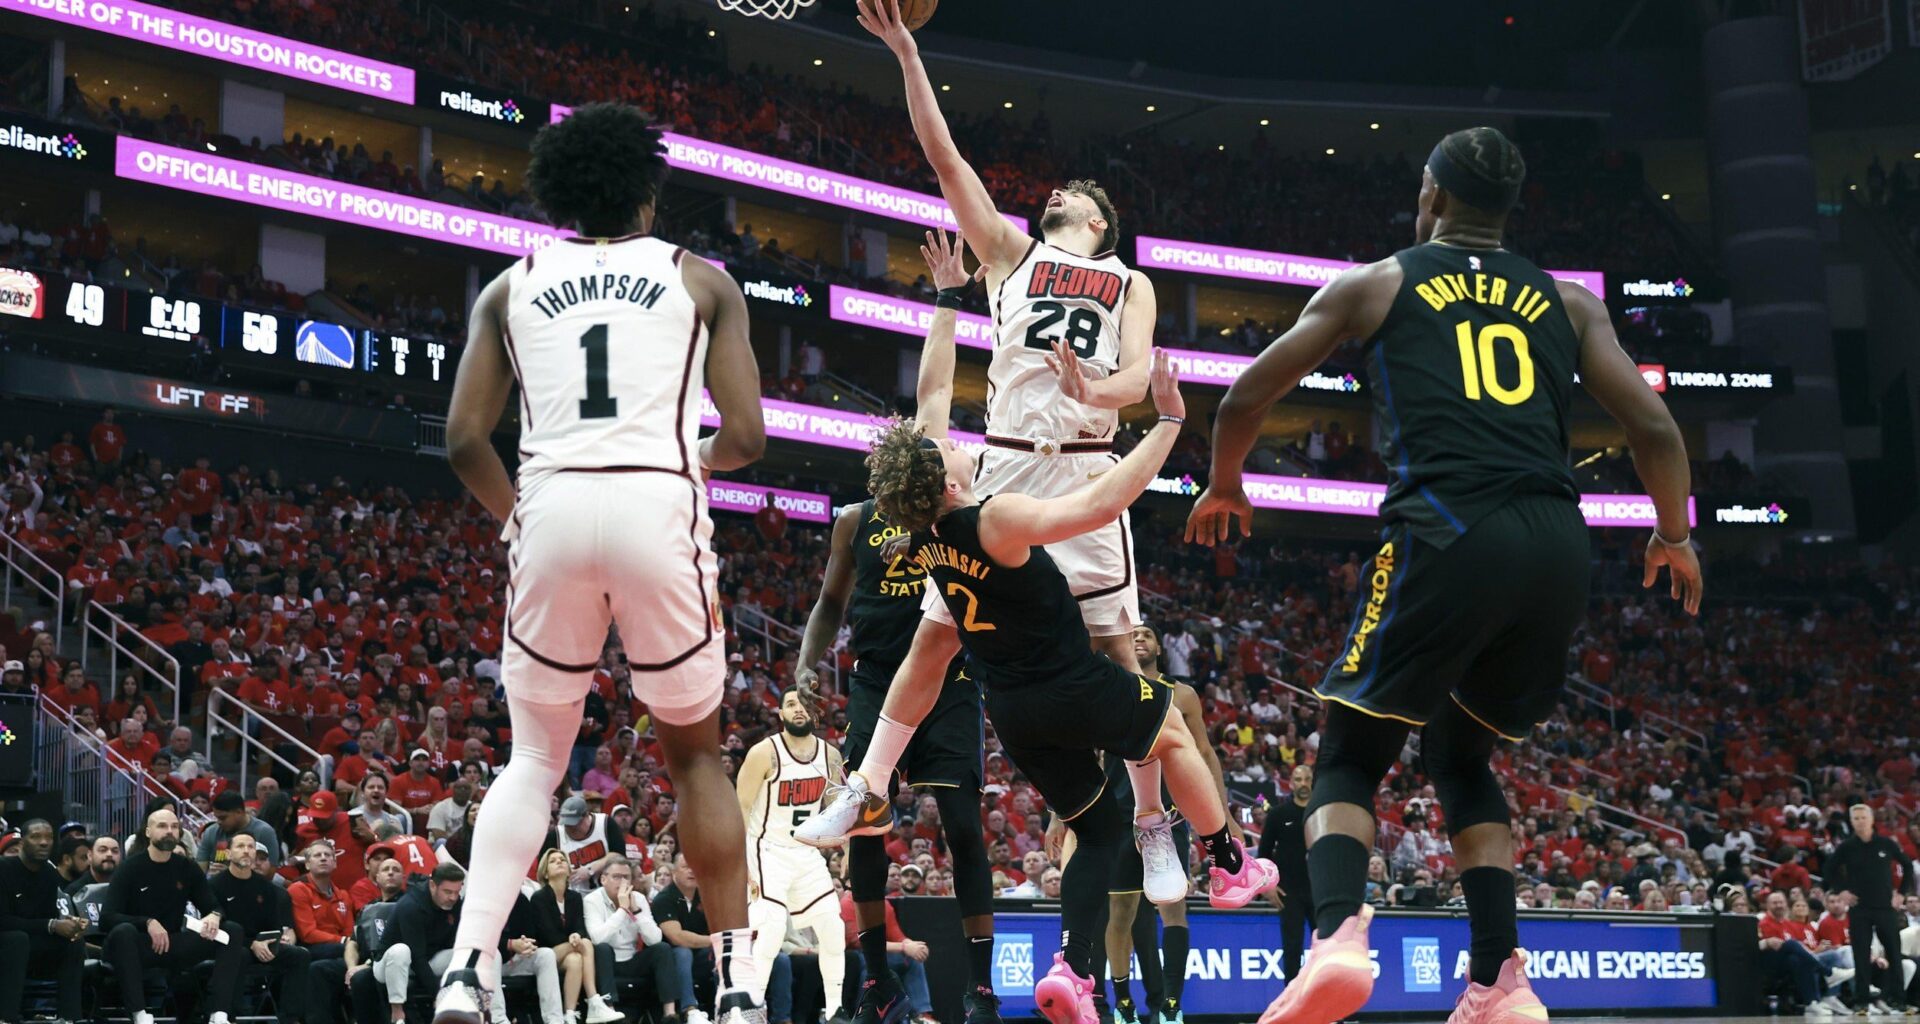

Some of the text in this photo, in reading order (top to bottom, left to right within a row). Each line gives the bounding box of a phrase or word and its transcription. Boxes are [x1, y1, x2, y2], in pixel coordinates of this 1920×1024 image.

[90, 3, 123, 25] OF
[127, 10, 174, 39] THE
[178, 23, 291, 67] HOUSTON
[294, 51, 393, 91] ROCKETS
[441, 91, 504, 120] reliant
[658, 140, 720, 168] NERGY
[722, 154, 804, 190] PROVIDER
[806, 175, 830, 194] OF
[831, 181, 864, 205] THE
[865, 189, 943, 222] HOUSTON
[136, 151, 244, 191] OFFICIAL
[247, 173, 337, 209] ENERGY
[340, 190, 446, 232] PROVIDER
[448, 215, 478, 238] OF
[480, 221, 522, 246] THE
[1151, 246, 1223, 269] OFFICIAL
[1225, 255, 1285, 276] ENERGY
[531, 274, 667, 319] THOMPSON
[744, 281, 797, 305] reliant
[1415, 273, 1552, 324] BUTLER III
[1622, 279, 1677, 297] reliant
[66, 282, 104, 327] 49
[842, 296, 917, 327] OFFICIAL
[1024, 301, 1102, 359] 28
[432, 358, 440, 381] 1
[579, 324, 618, 420] 1
[1455, 320, 1535, 405] 10
[1668, 372, 1727, 387] TUNDRA
[1730, 373, 1773, 388] ZONE
[711, 487, 763, 508] ENERGY
[764, 495, 825, 515] OVIDER
[1306, 486, 1373, 508] ENERGY
[1716, 506, 1769, 523] reliant
[868, 525, 911, 547] GOL
[947, 582, 997, 632] 2
[408, 843, 424, 868] 4
[998, 944, 1033, 964] AM
[1413, 945, 1440, 964] AM
[1453, 949, 1706, 979] ARICAN EXPRESS
[1003, 966, 1034, 986] EX
[1416, 965, 1441, 984] EX
